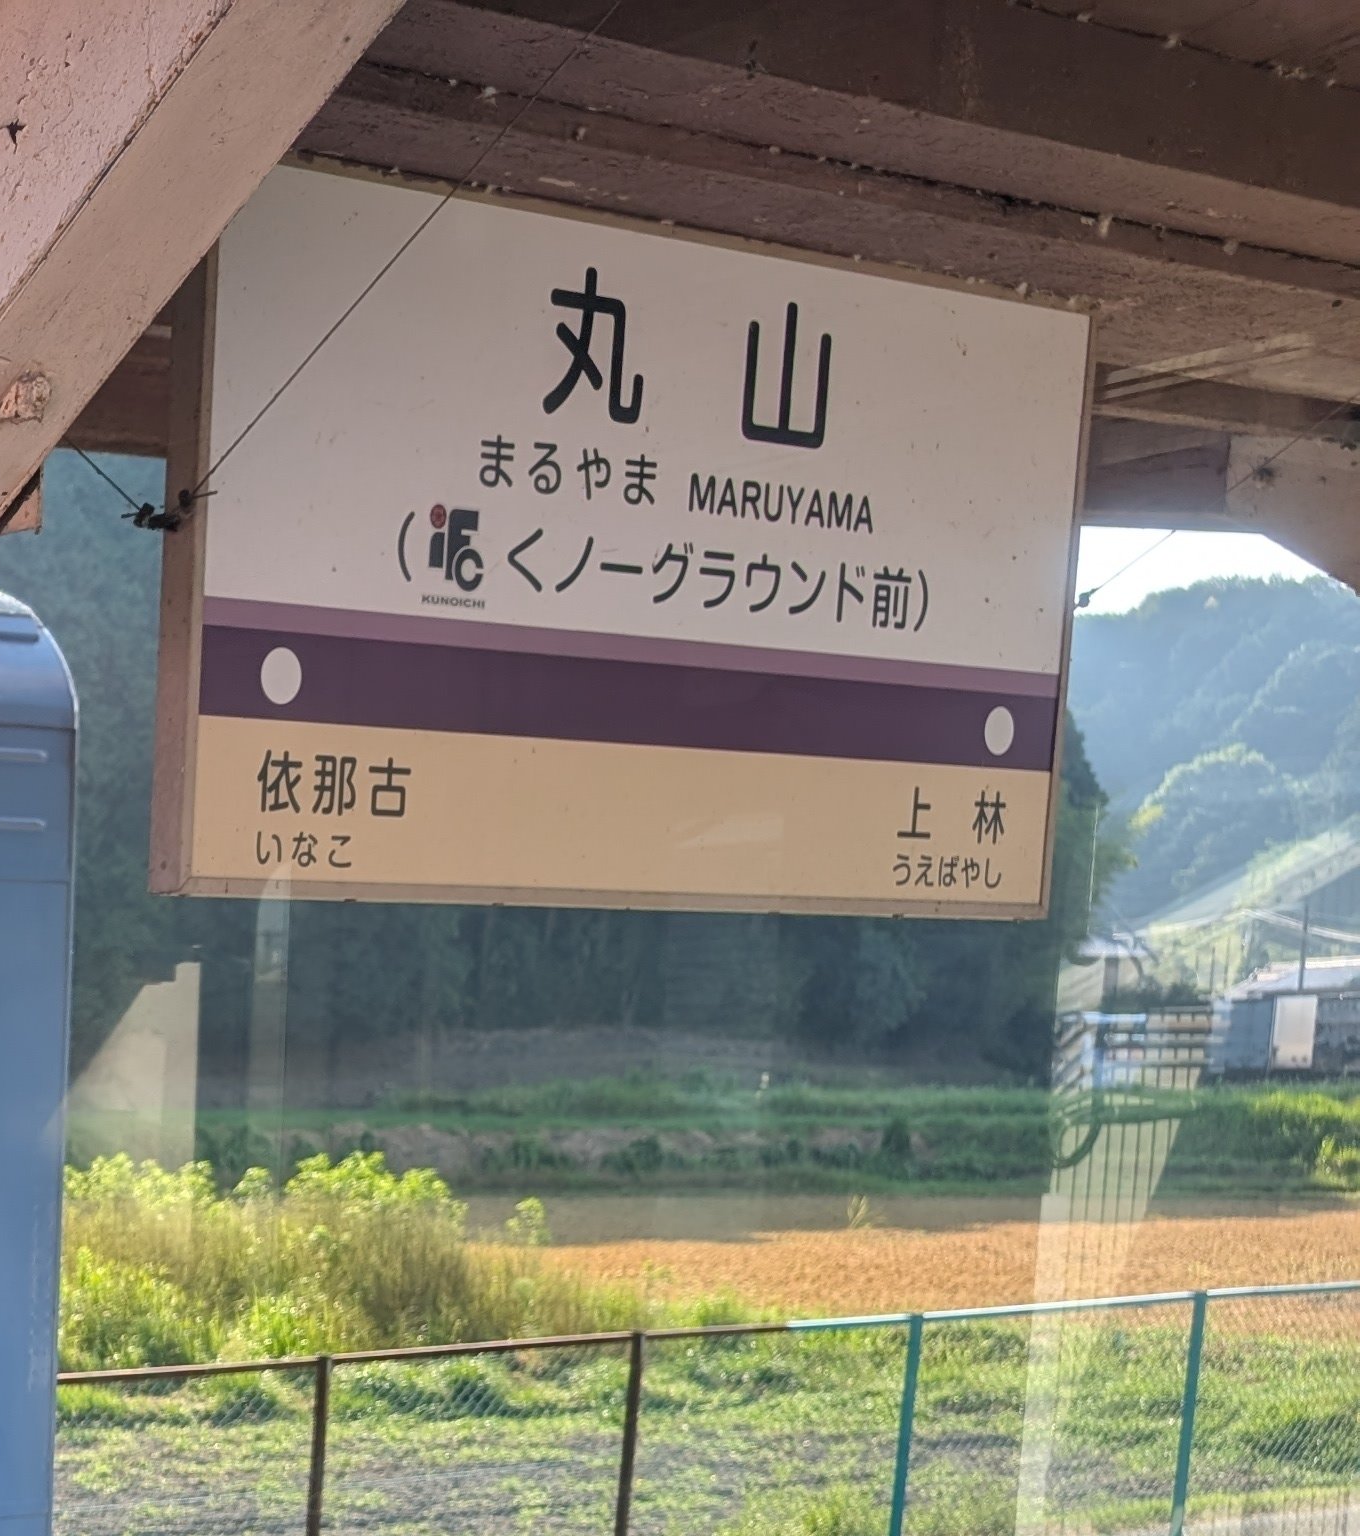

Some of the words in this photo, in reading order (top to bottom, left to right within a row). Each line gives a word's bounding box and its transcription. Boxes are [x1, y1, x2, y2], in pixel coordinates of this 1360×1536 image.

[542, 266, 832, 449] 丸山
[478, 434, 659, 506] まるやま
[689, 473, 873, 535] MARUYAMA
[420, 594, 486, 609] KUNOICHI
[256, 749, 411, 819] 依那古
[896, 787, 1006, 845] 上林
[255, 830, 354, 870] いなこ
[892, 855, 1002, 889] うえばやし
